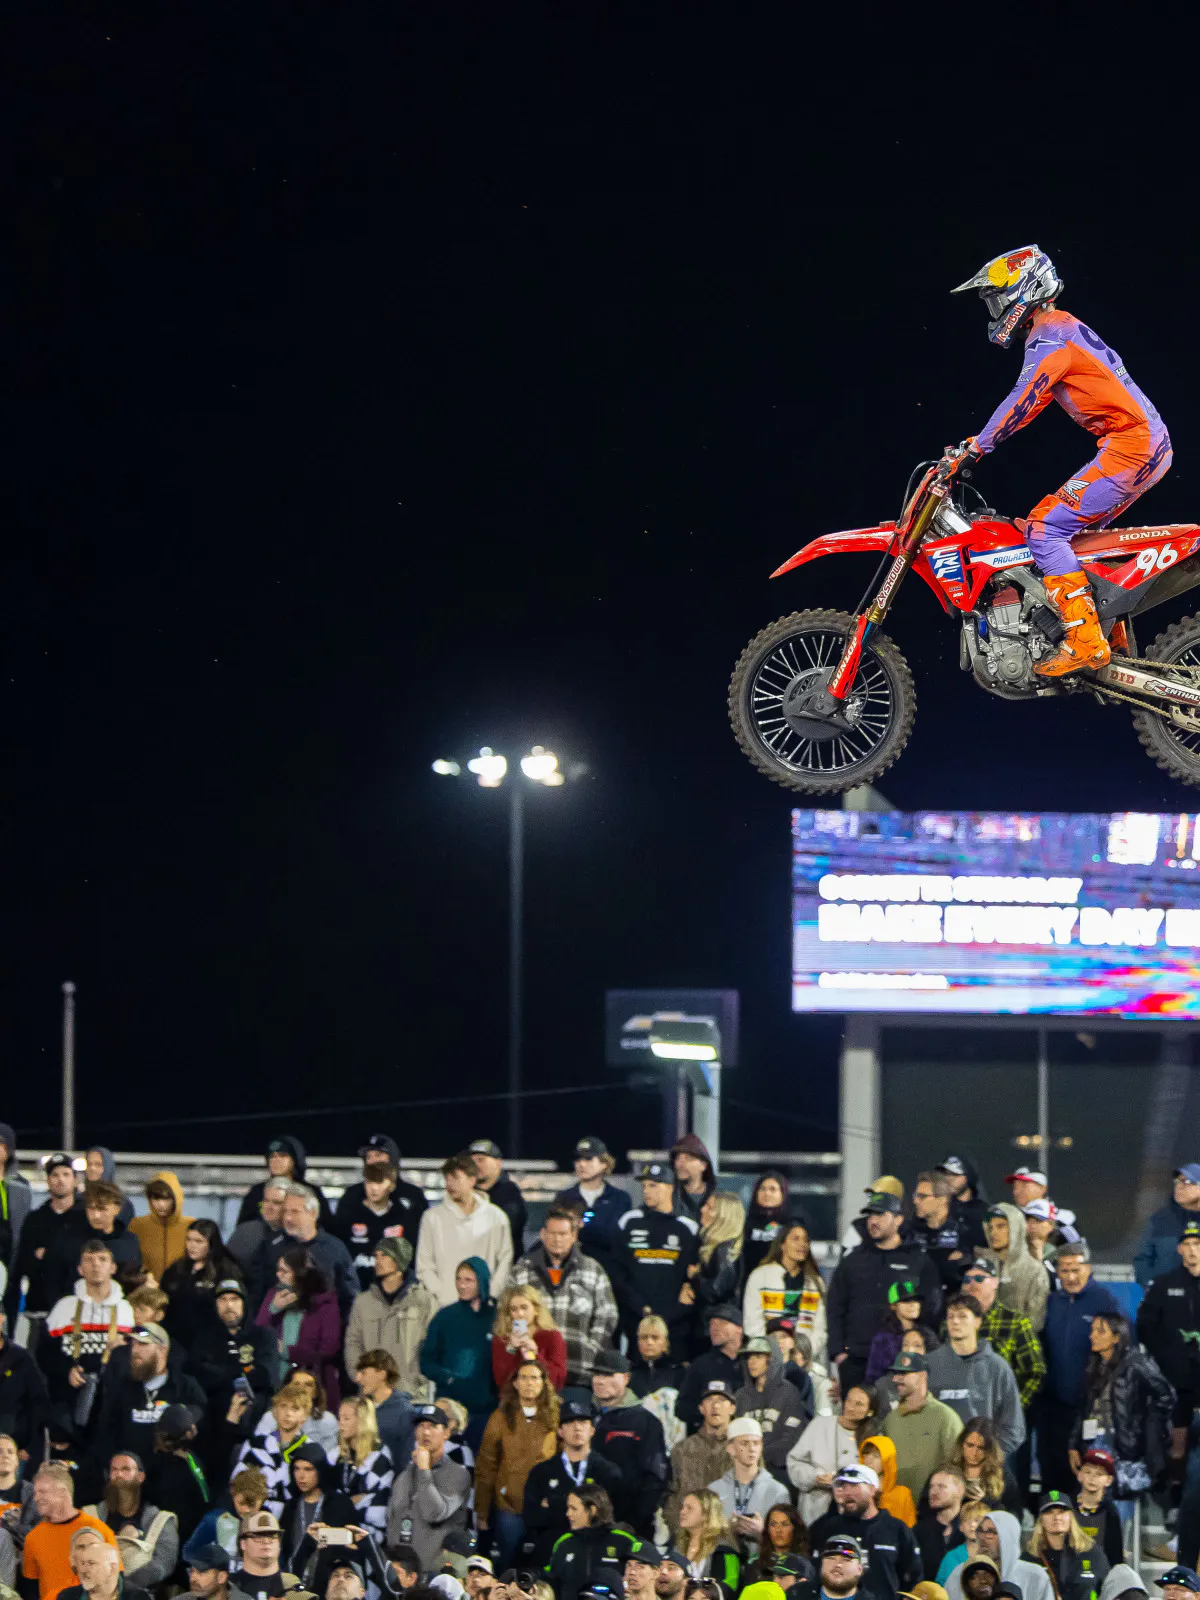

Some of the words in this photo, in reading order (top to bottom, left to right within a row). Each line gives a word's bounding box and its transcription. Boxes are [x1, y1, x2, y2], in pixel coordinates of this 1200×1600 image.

[1119, 530, 1171, 542] HONDA
[883, 556, 905, 593] SHOWA
[1136, 543, 1178, 578] 96
[832, 637, 858, 689] DUNLOP
